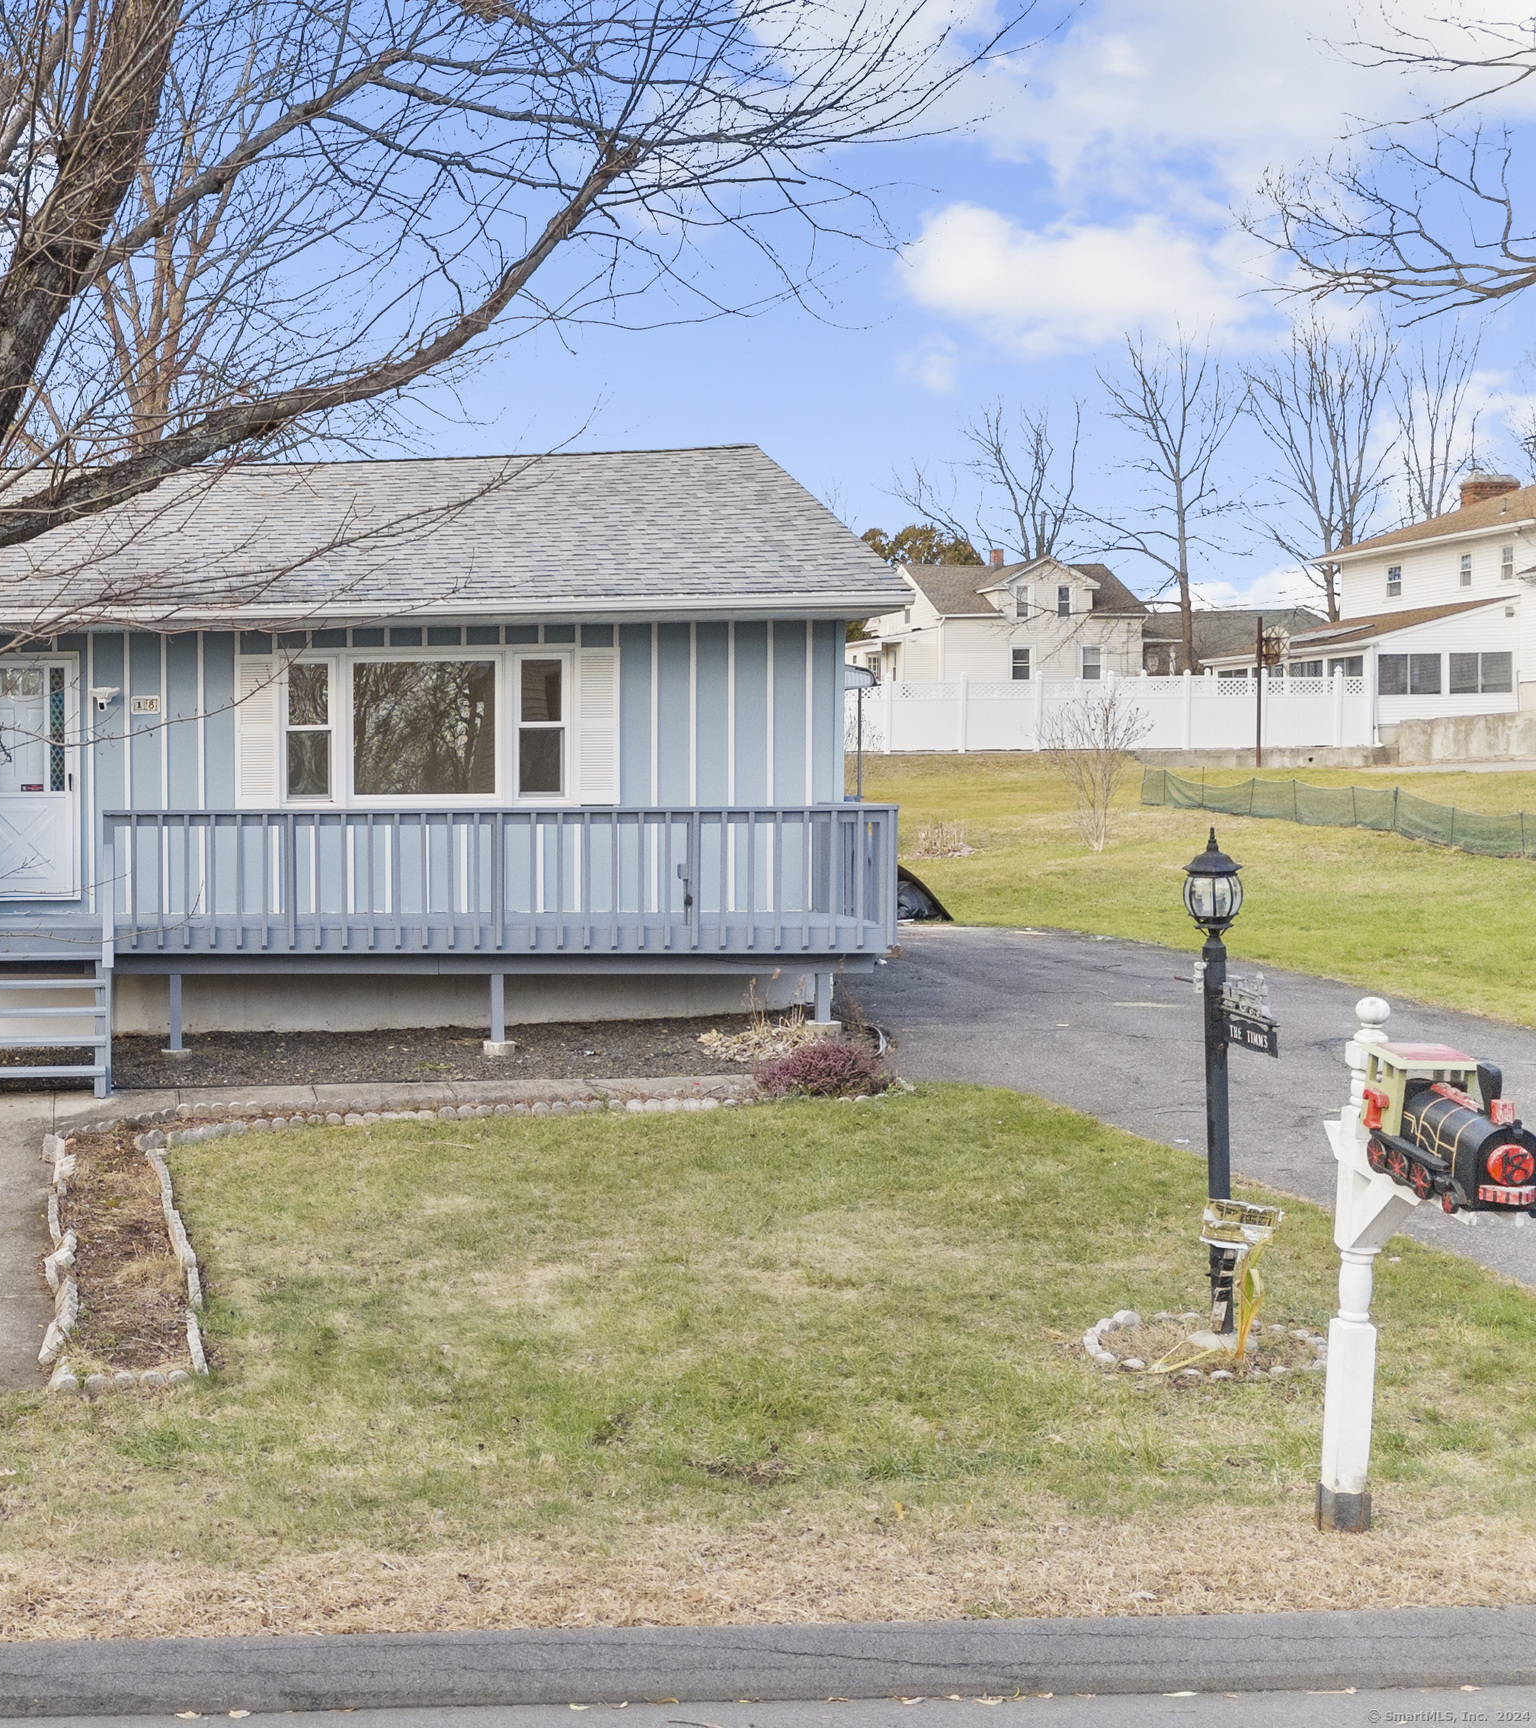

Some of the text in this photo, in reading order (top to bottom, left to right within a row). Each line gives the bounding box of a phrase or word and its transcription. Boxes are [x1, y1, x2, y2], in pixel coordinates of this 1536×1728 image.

[137, 701, 154, 710] 18
[1229, 1024, 1242, 1040] THE
[1501, 1151, 1529, 1186] 18
